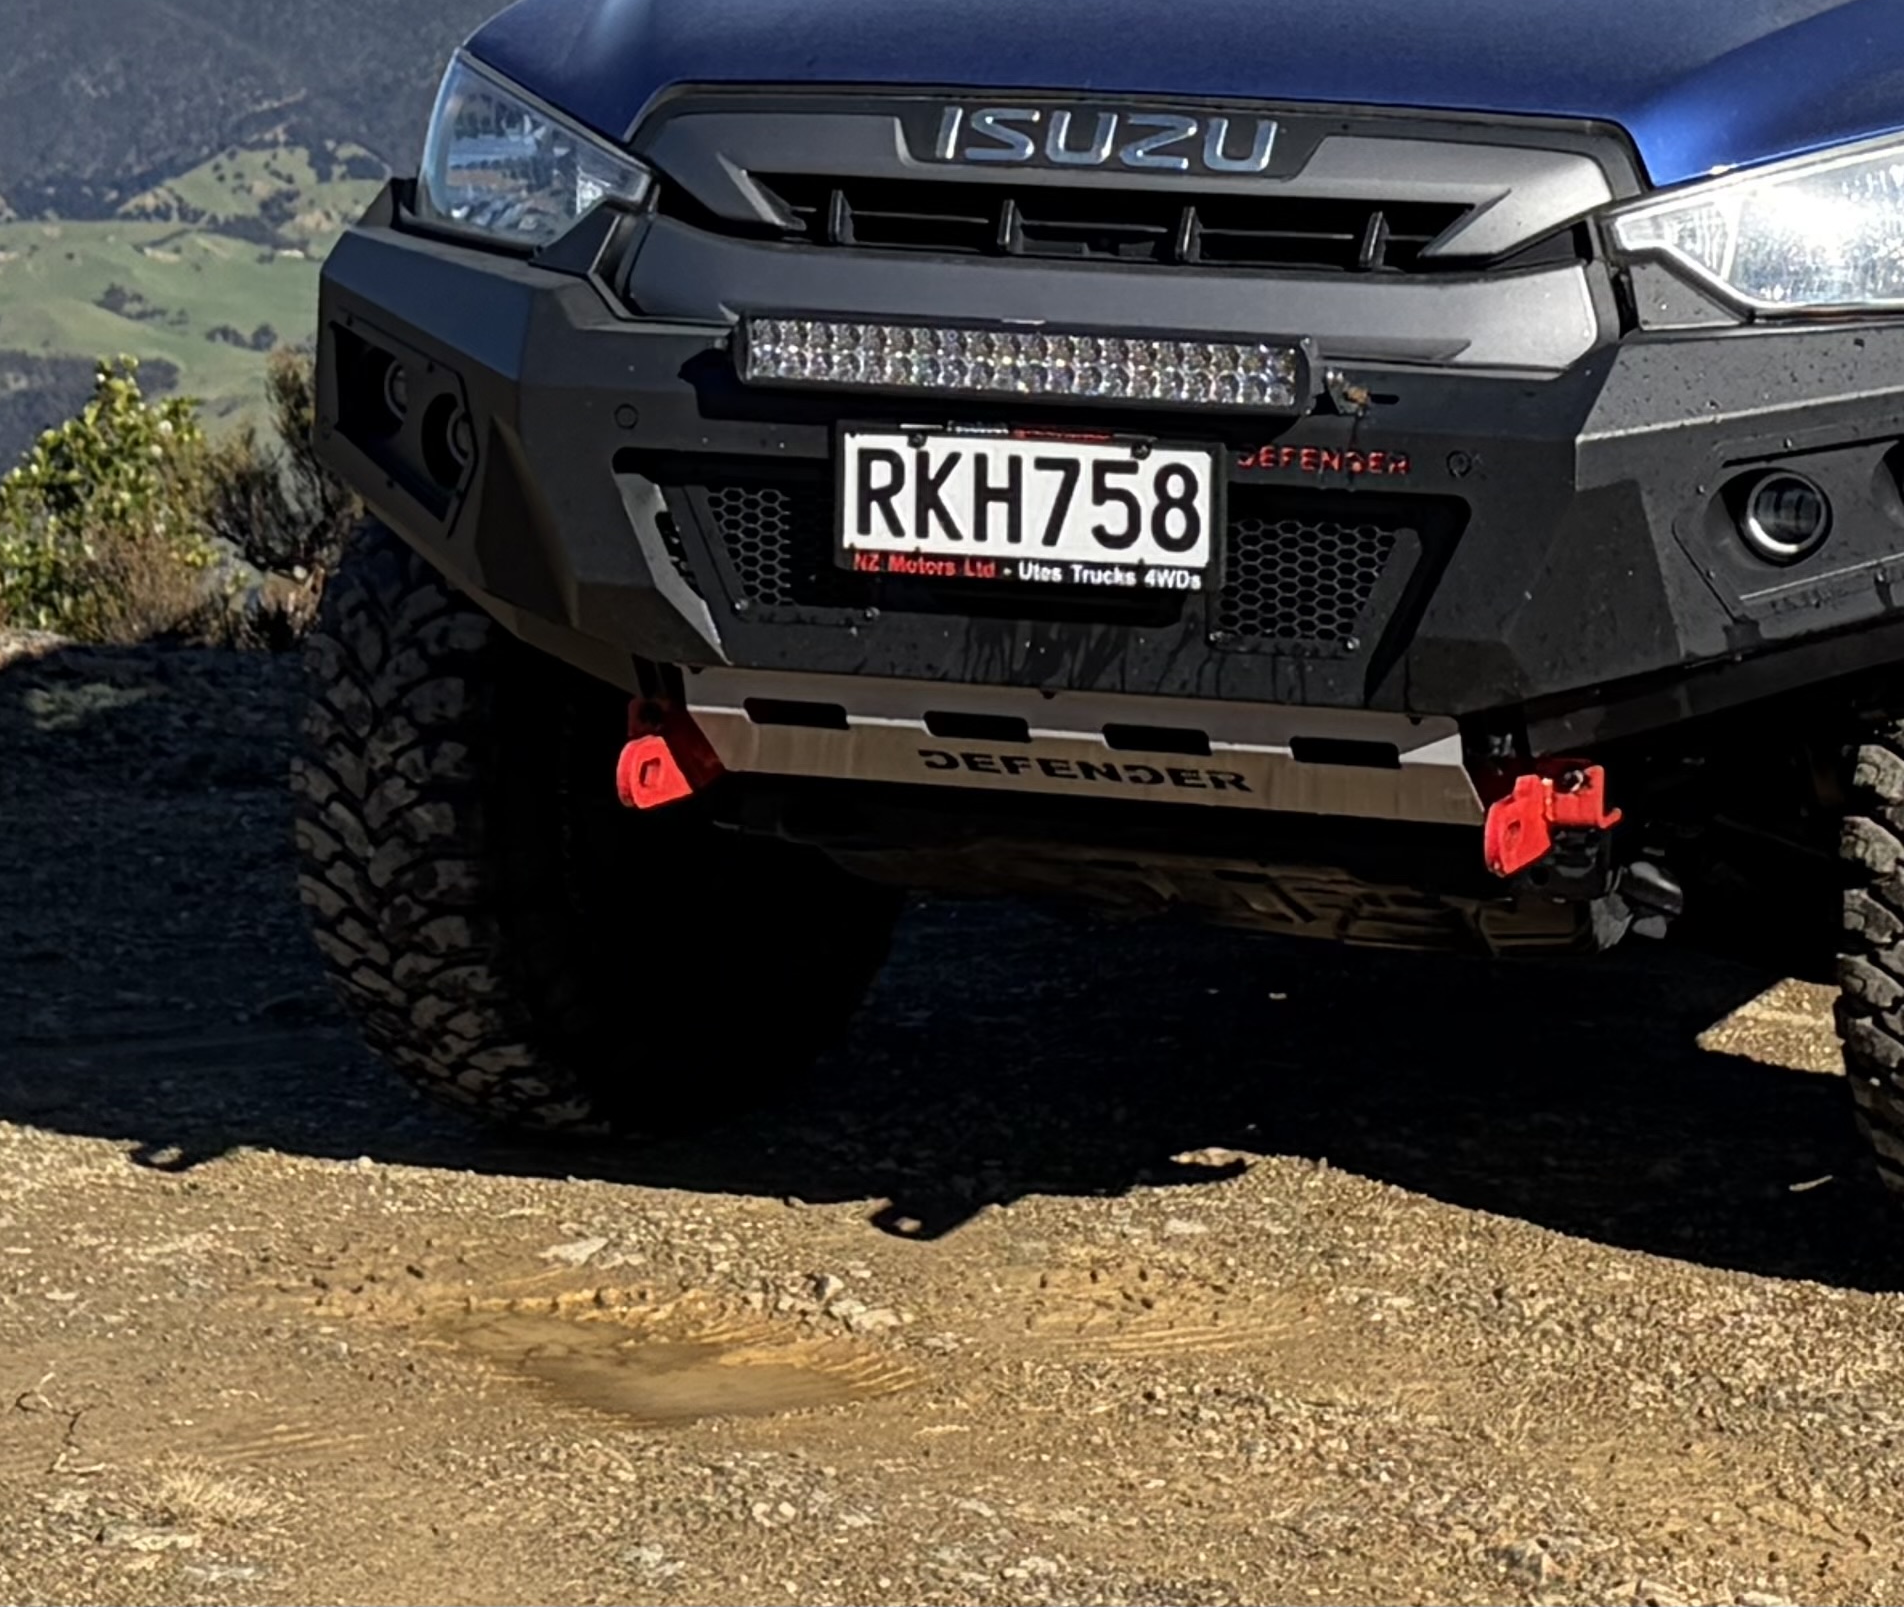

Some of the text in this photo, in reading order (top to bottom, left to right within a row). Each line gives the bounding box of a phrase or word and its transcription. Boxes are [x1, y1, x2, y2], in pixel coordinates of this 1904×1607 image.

[935, 106, 1279, 173] ISUZU
[1236, 445, 1411, 475] DEFENDER
[856, 447, 1201, 553] RKH758
[853, 552, 881, 572] NZ
[888, 554, 956, 577] Motors
[964, 557, 996, 579] Ltd
[1018, 560, 1063, 582] Utes
[1070, 564, 1138, 586] Trucks
[1143, 568, 1203, 590] 4WDs
[917, 749, 1254, 793] DEFENDER
